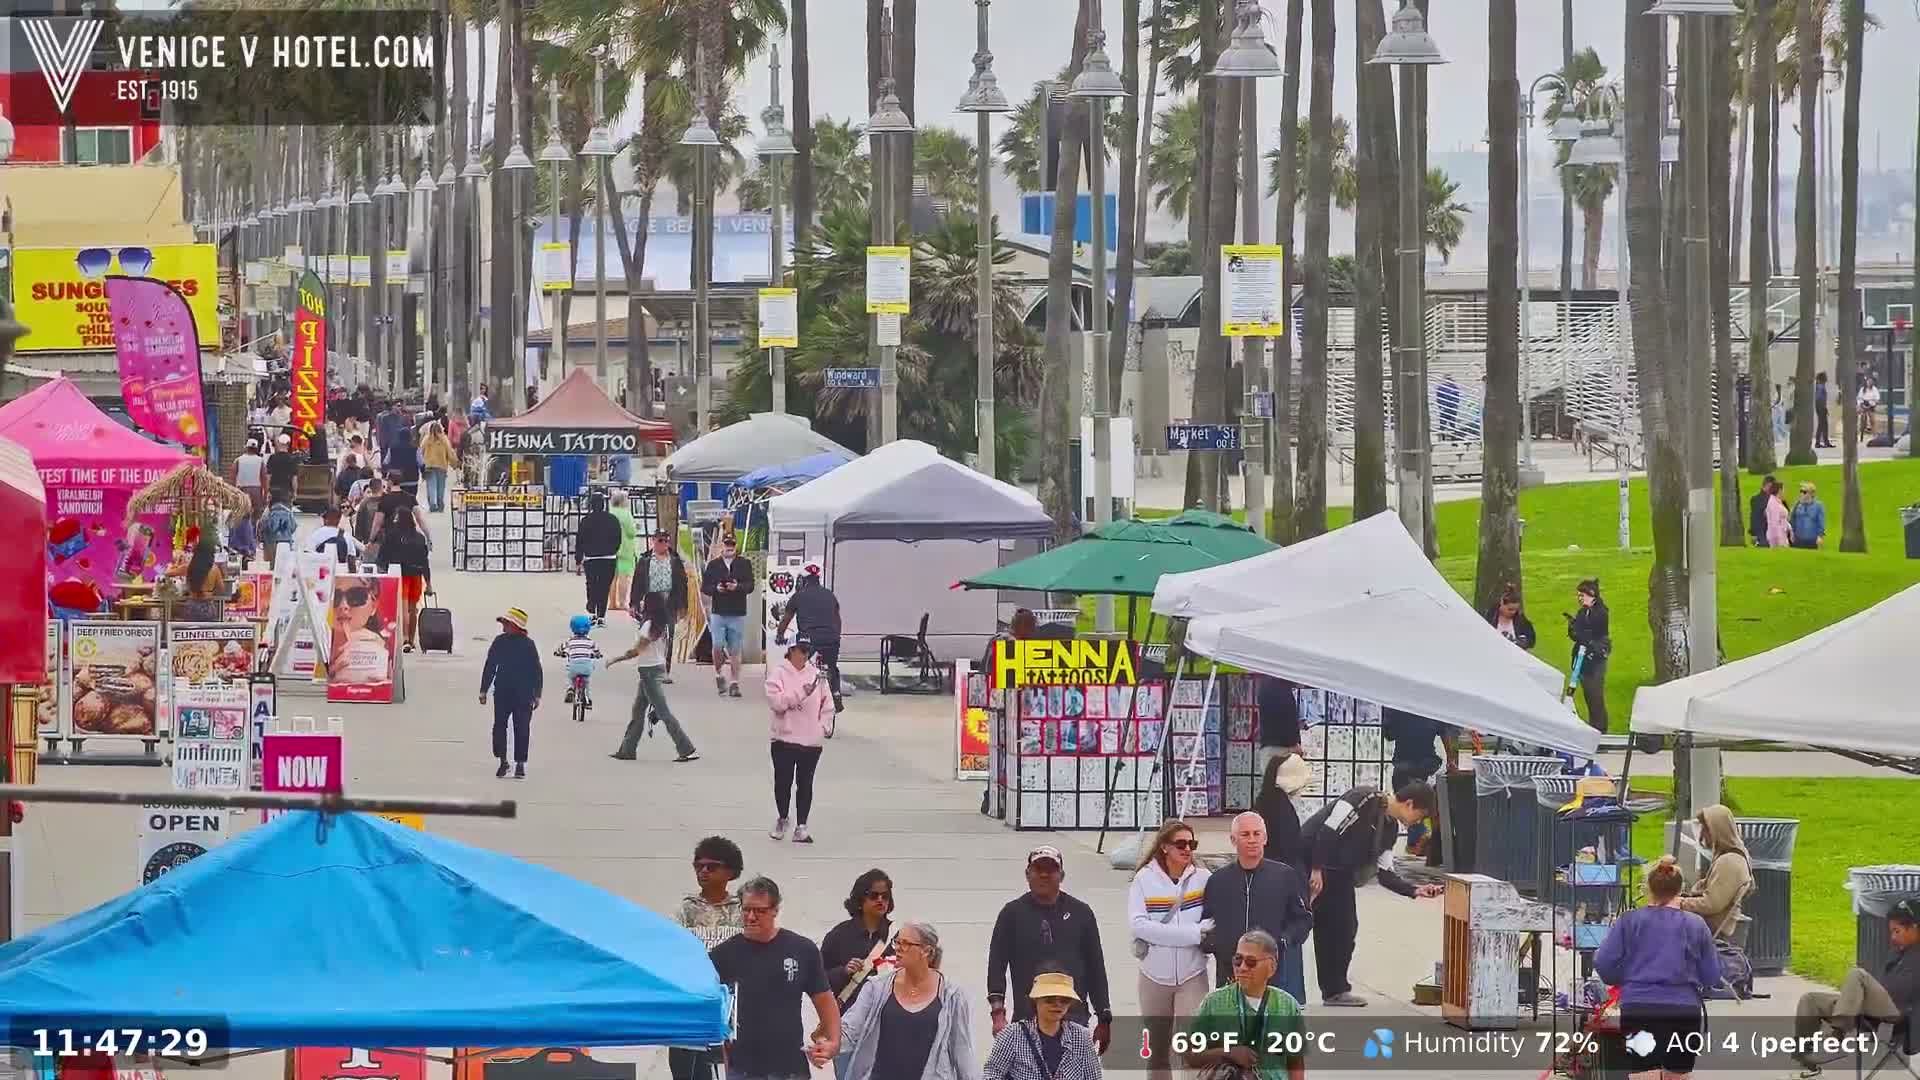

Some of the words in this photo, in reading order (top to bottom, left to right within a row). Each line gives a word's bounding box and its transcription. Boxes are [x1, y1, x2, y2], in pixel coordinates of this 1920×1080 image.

[827, 367, 867, 380] Windward
[489, 429, 555, 452] HENNA
[559, 433, 637, 452] TATTOO
[1169, 427, 1209, 440] Market
[1223, 426, 1236, 440] St
[38, 468, 67, 484] TEST
[70, 468, 98, 484] TIME
[101, 468, 117, 484] OF
[119, 467, 142, 484] THE
[57, 501, 103, 515] SANDWICH
[174, 630, 218, 640] FUNNEL
[221, 630, 252, 639] CAKE
[996, 639, 1137, 689] HENNA
[277, 755, 328, 788] NOW
[149, 814, 220, 832] OPEN
